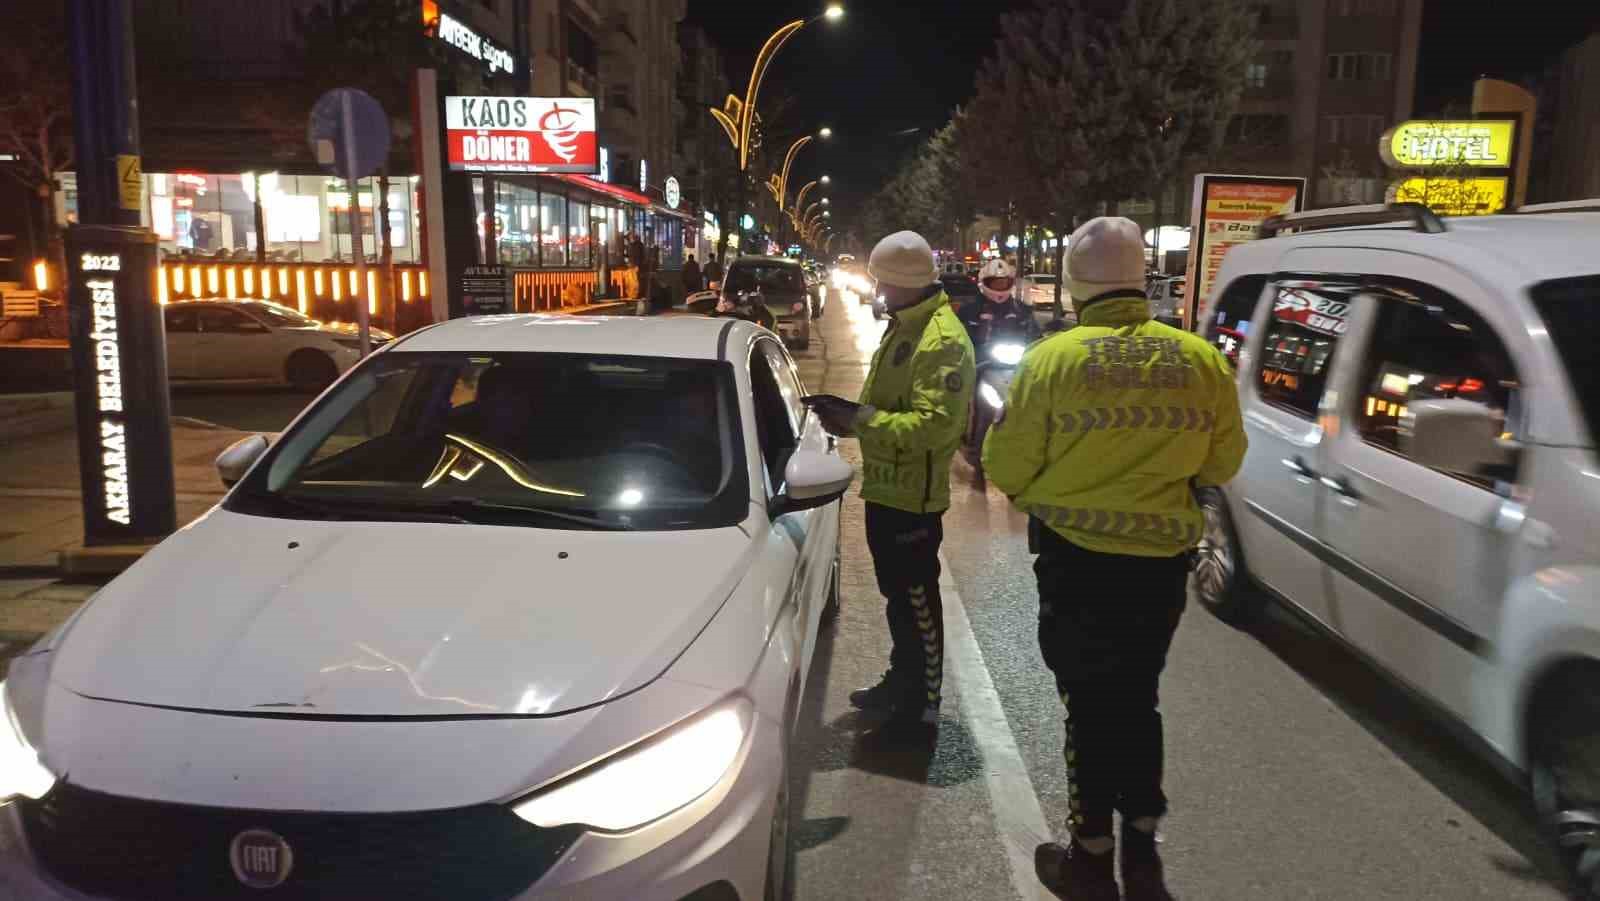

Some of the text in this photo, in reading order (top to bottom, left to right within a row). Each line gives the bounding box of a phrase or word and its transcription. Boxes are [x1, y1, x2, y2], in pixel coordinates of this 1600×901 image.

[439, 13, 482, 60] AYBERK
[462, 98, 527, 128] KAOS
[462, 130, 530, 162] DÖNER
[1409, 135, 1498, 161] HOTEL
[81, 254, 120, 271] 2022
[86, 279, 130, 525] AKSARAY BELEDİYESİ
[243, 845, 277, 873] FIAT
